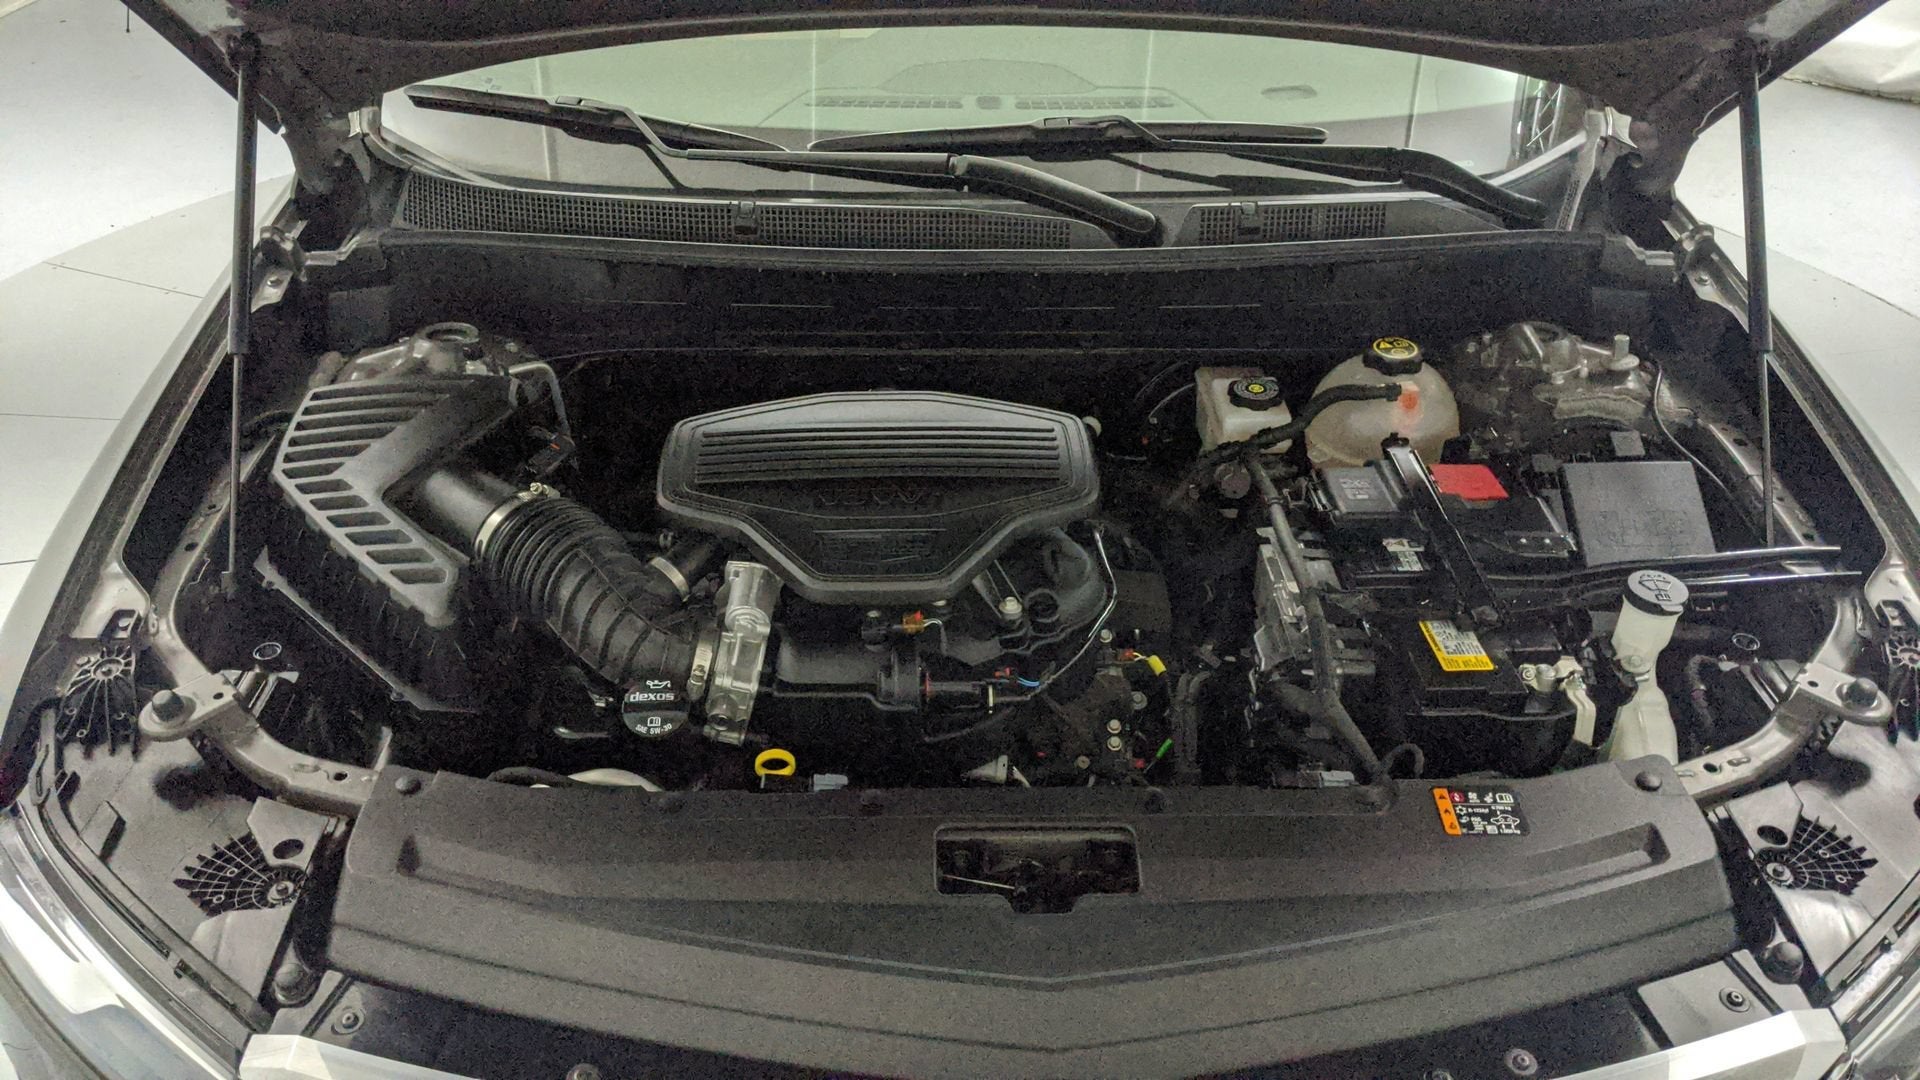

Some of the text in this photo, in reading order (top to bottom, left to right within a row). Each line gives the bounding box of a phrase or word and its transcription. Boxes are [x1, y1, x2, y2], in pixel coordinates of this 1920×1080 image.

[630, 692, 675, 702] dexos
[635, 723, 673, 734] SAE 5W-30
